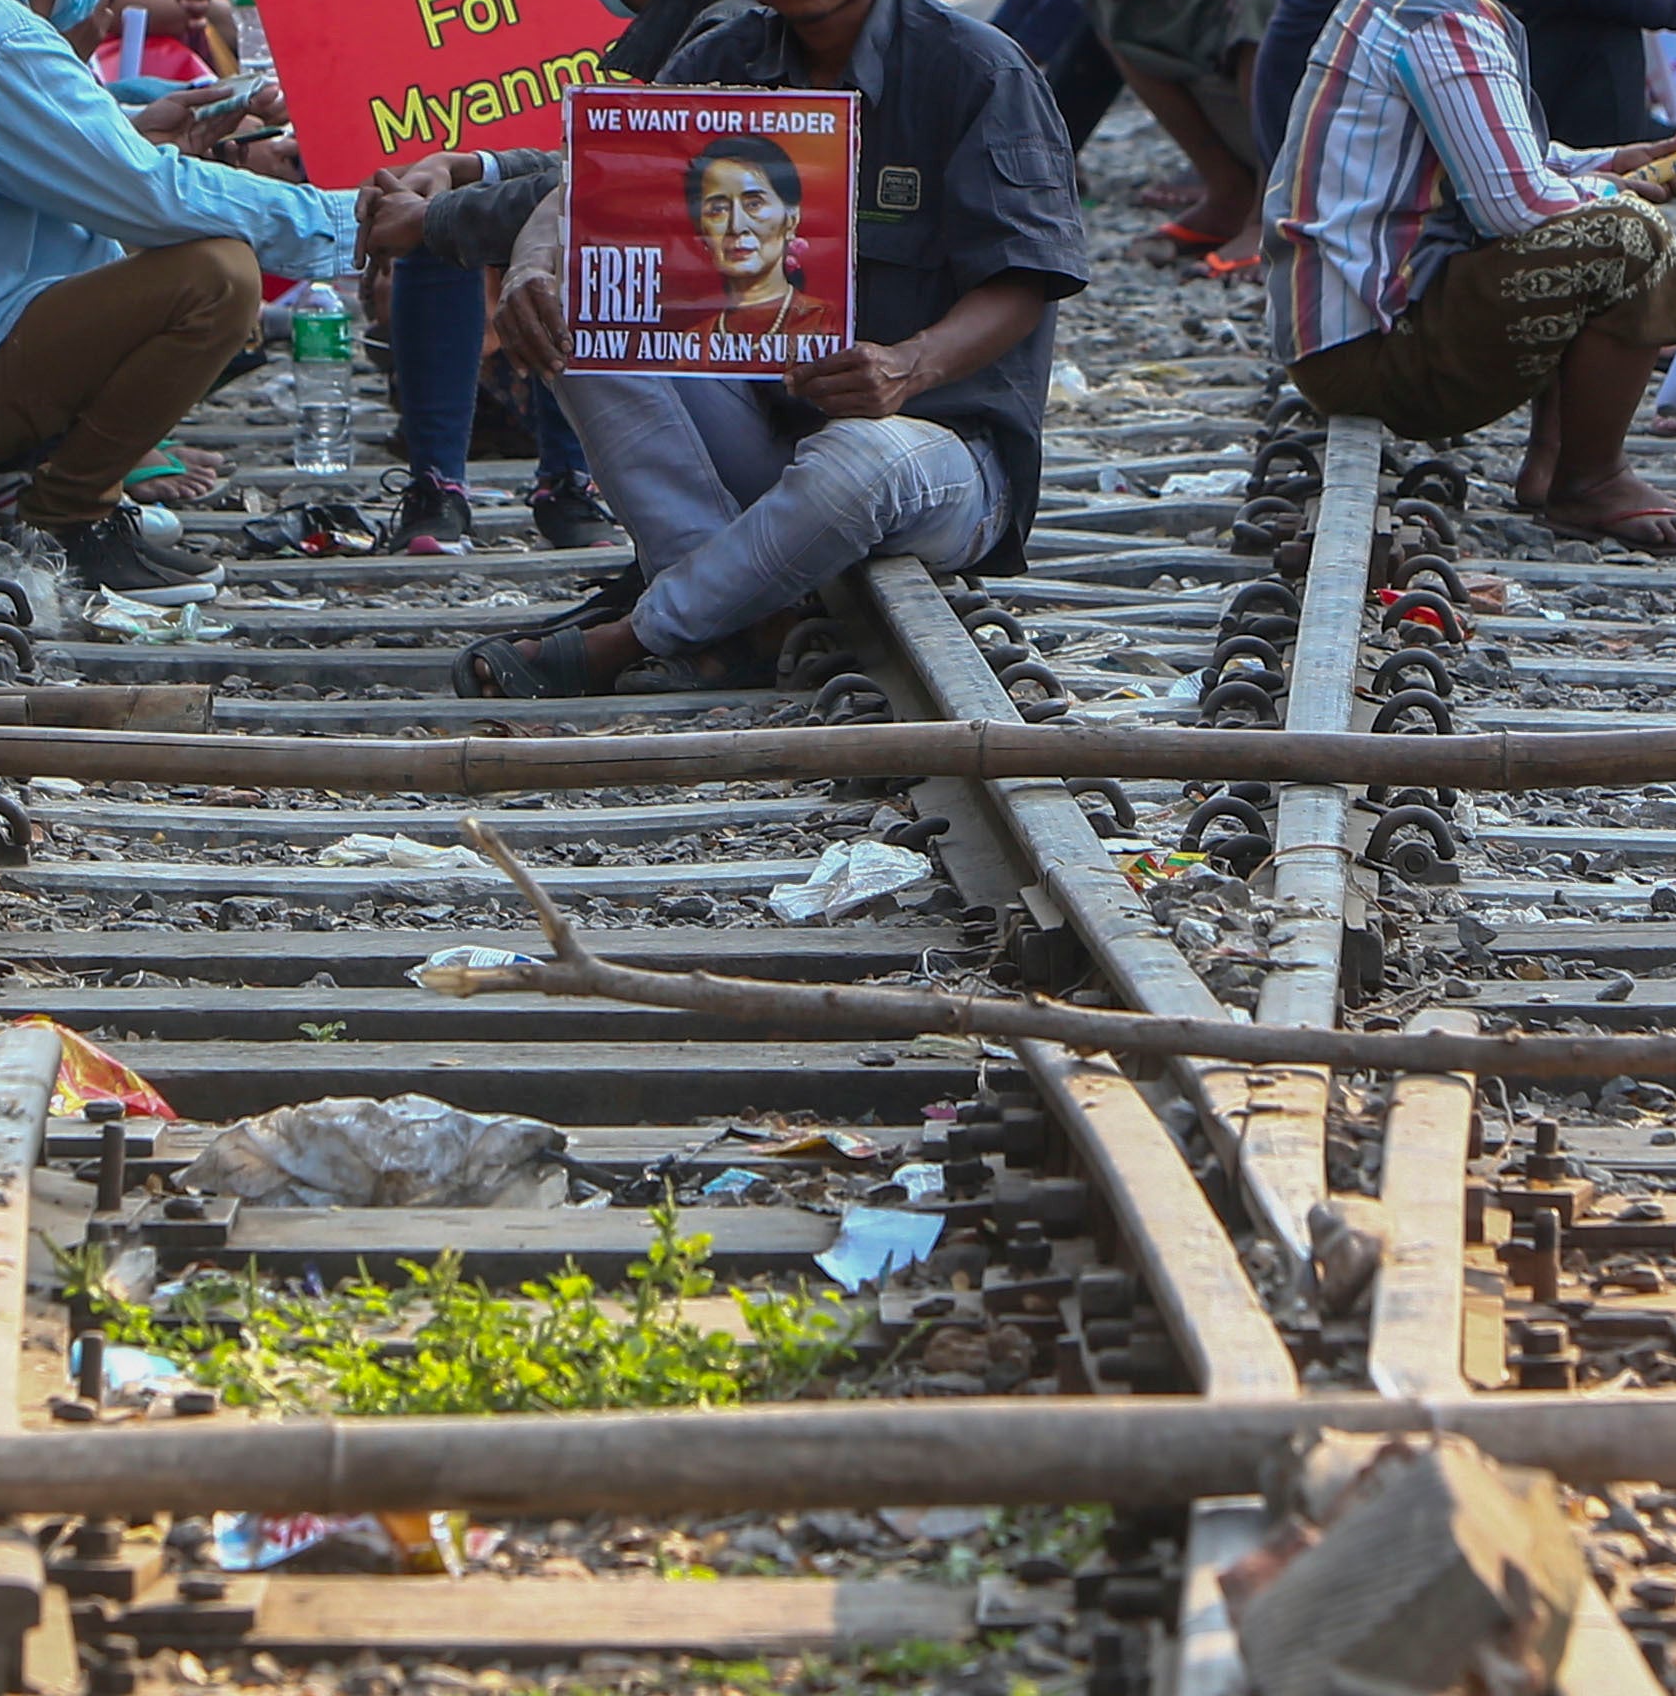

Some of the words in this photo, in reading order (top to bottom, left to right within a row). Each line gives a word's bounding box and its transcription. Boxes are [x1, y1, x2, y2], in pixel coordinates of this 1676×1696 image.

[587, 109, 621, 131] WE
[628, 110, 690, 132] WANT
[695, 110, 742, 133] OUR
[750, 111, 836, 134] LEADER
[578, 245, 662, 324] FREE
[575, 329, 629, 359] DAW
[637, 331, 701, 361] AUNG
[710, 333, 753, 362] SAN
[760, 334, 789, 363] SU
[796, 334, 841, 364] KYI
